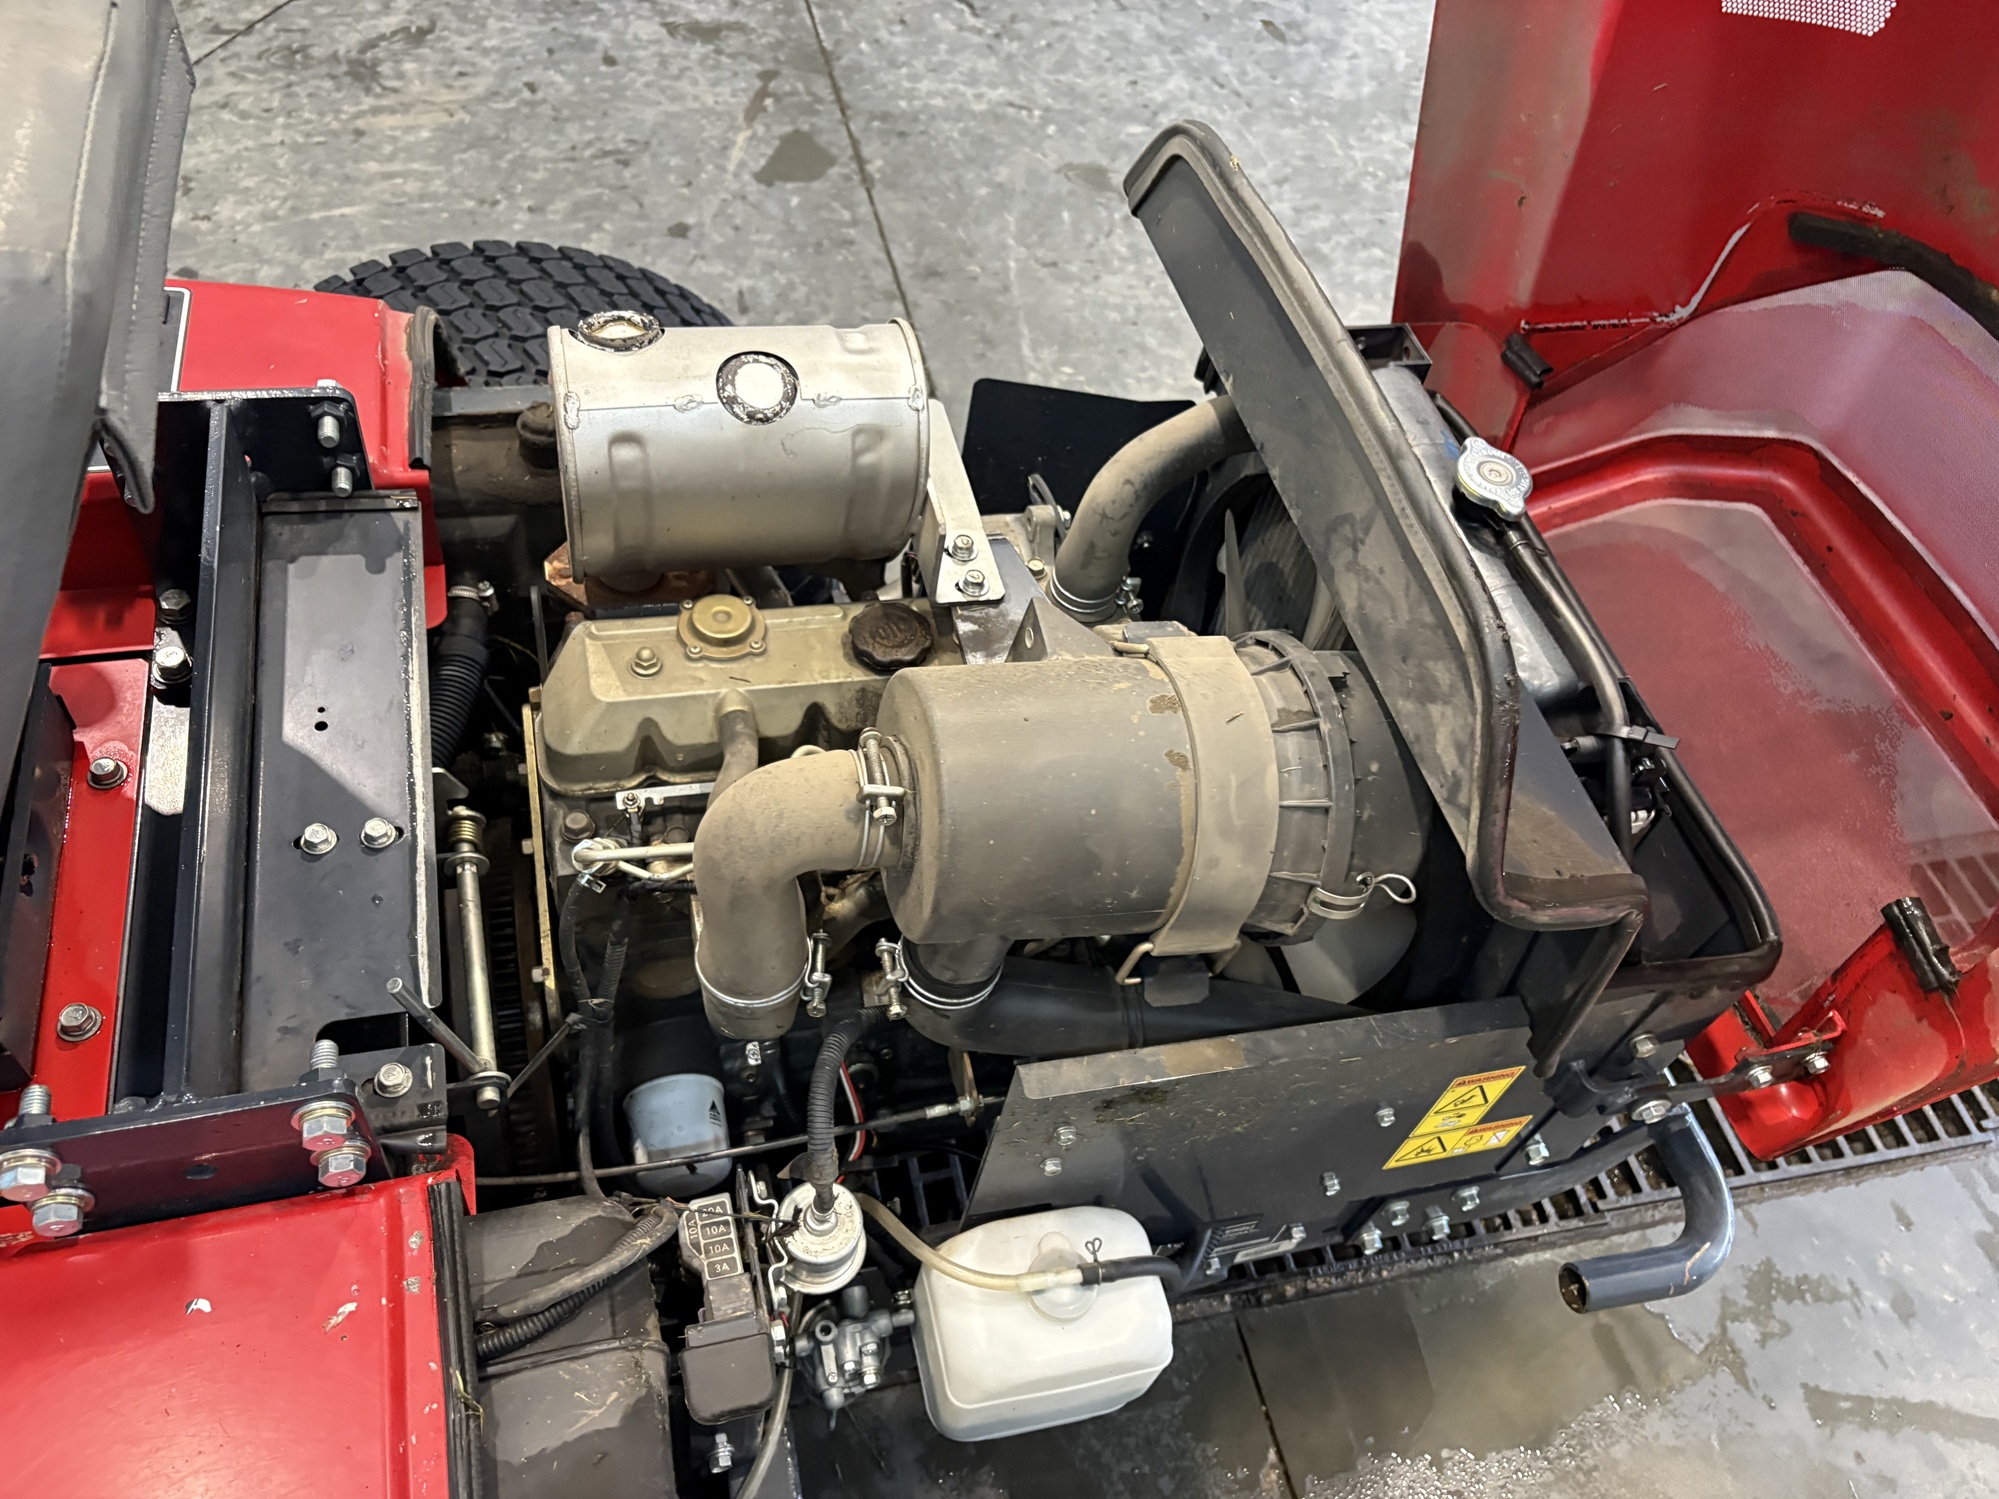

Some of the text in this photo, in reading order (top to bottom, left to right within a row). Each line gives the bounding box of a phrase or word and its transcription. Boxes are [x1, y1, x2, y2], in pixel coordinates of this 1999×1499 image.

[1466, 1072, 1514, 1084] WARNING
[688, 1219, 698, 1239] 10A
[705, 1224, 727, 1236] 10A
[708, 1243, 730, 1254] 10A
[714, 1262, 730, 1273] 3A
